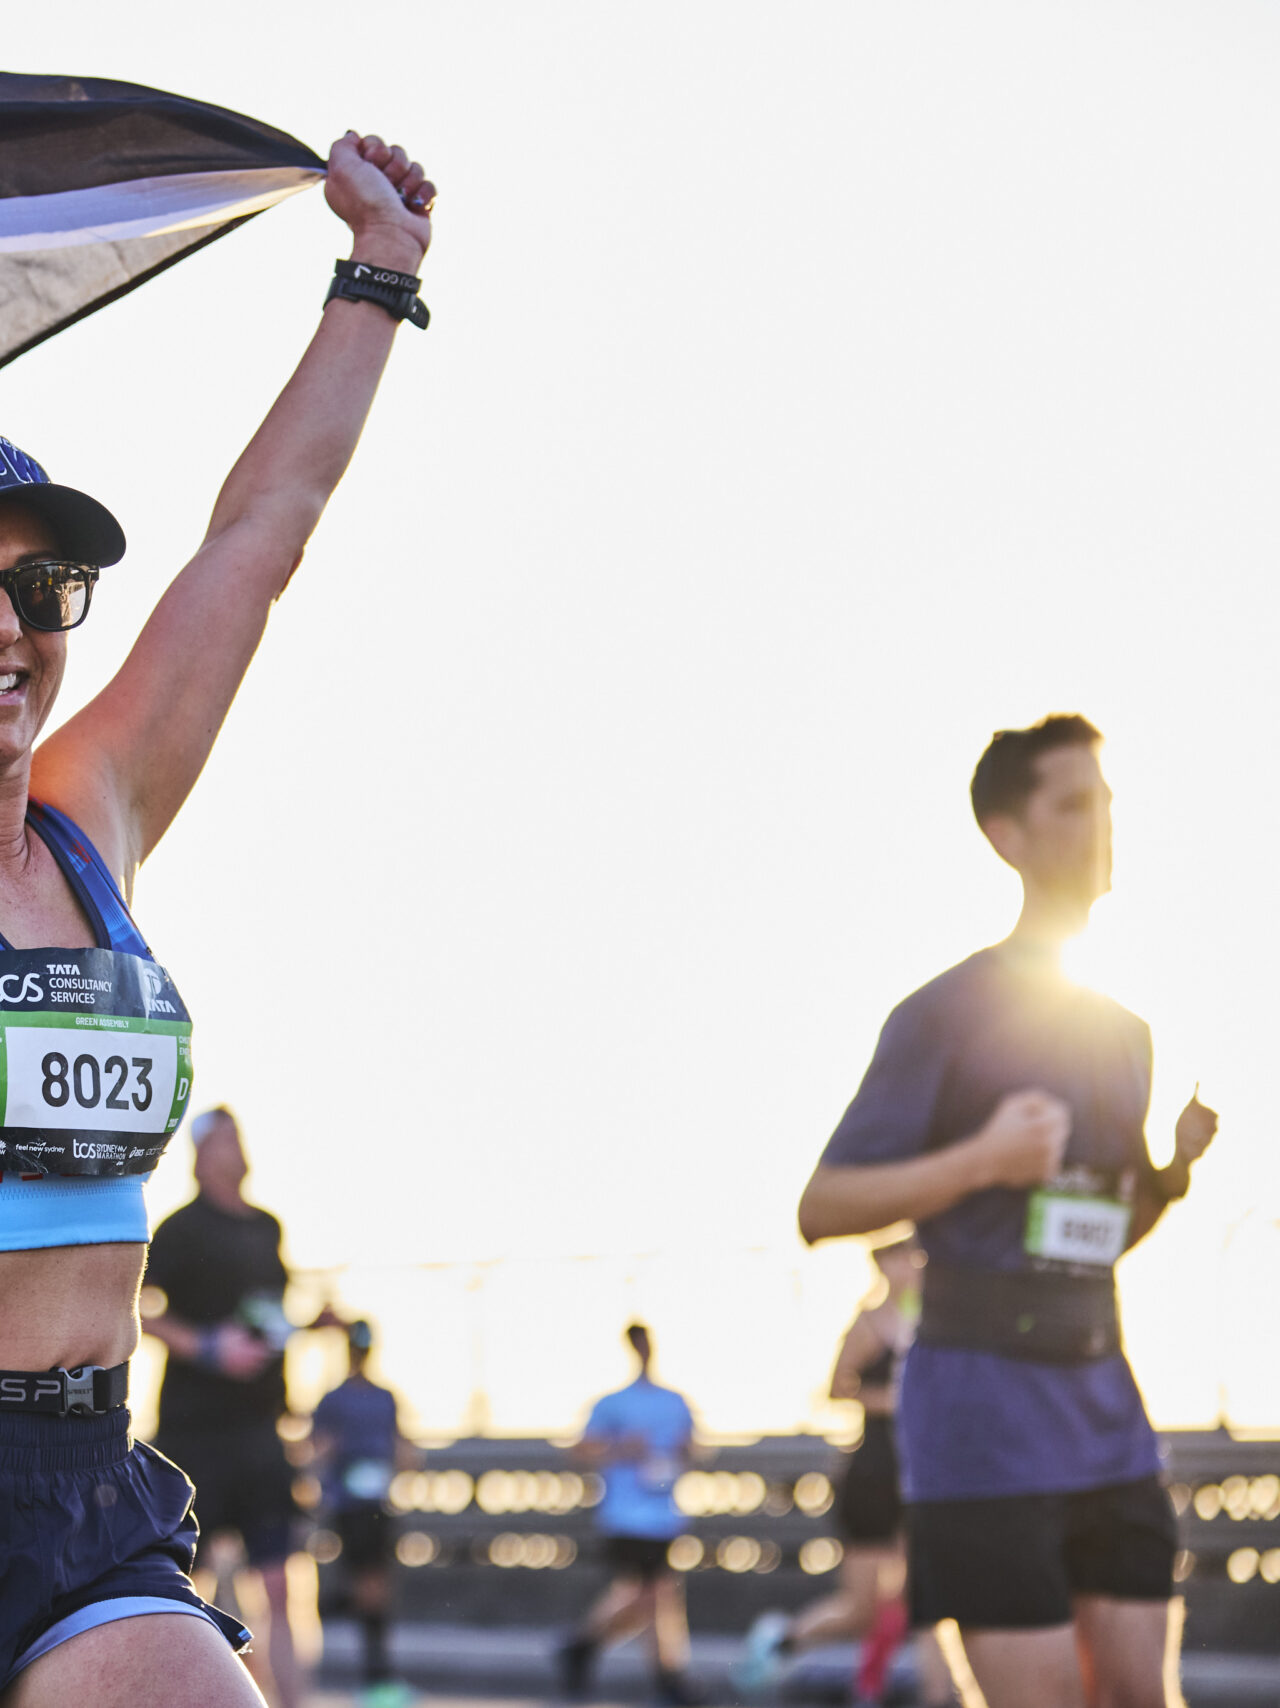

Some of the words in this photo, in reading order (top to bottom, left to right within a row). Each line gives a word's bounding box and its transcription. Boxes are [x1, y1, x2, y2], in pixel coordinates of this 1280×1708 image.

[46, 964, 81, 976] TATA
[48, 977, 113, 993] CONSULTANCY
[50, 991, 96, 1004] SERVICES
[146, 998, 177, 1014] ATA
[75, 1016, 98, 1026] GREEN
[99, 1018, 129, 1029] ASSEMBLY
[41, 1051, 154, 1112] 8023
[176, 1077, 190, 1101] D
[15, 1143, 29, 1151] feel
[29, 1144, 44, 1152] new
[44, 1145, 66, 1155] sydney
[72, 1138, 97, 1160] tcs
[96, 1143, 118, 1153] SYDNEY
[96, 1152, 127, 1160] MARATHON
[0, 1378, 62, 1402] SP
